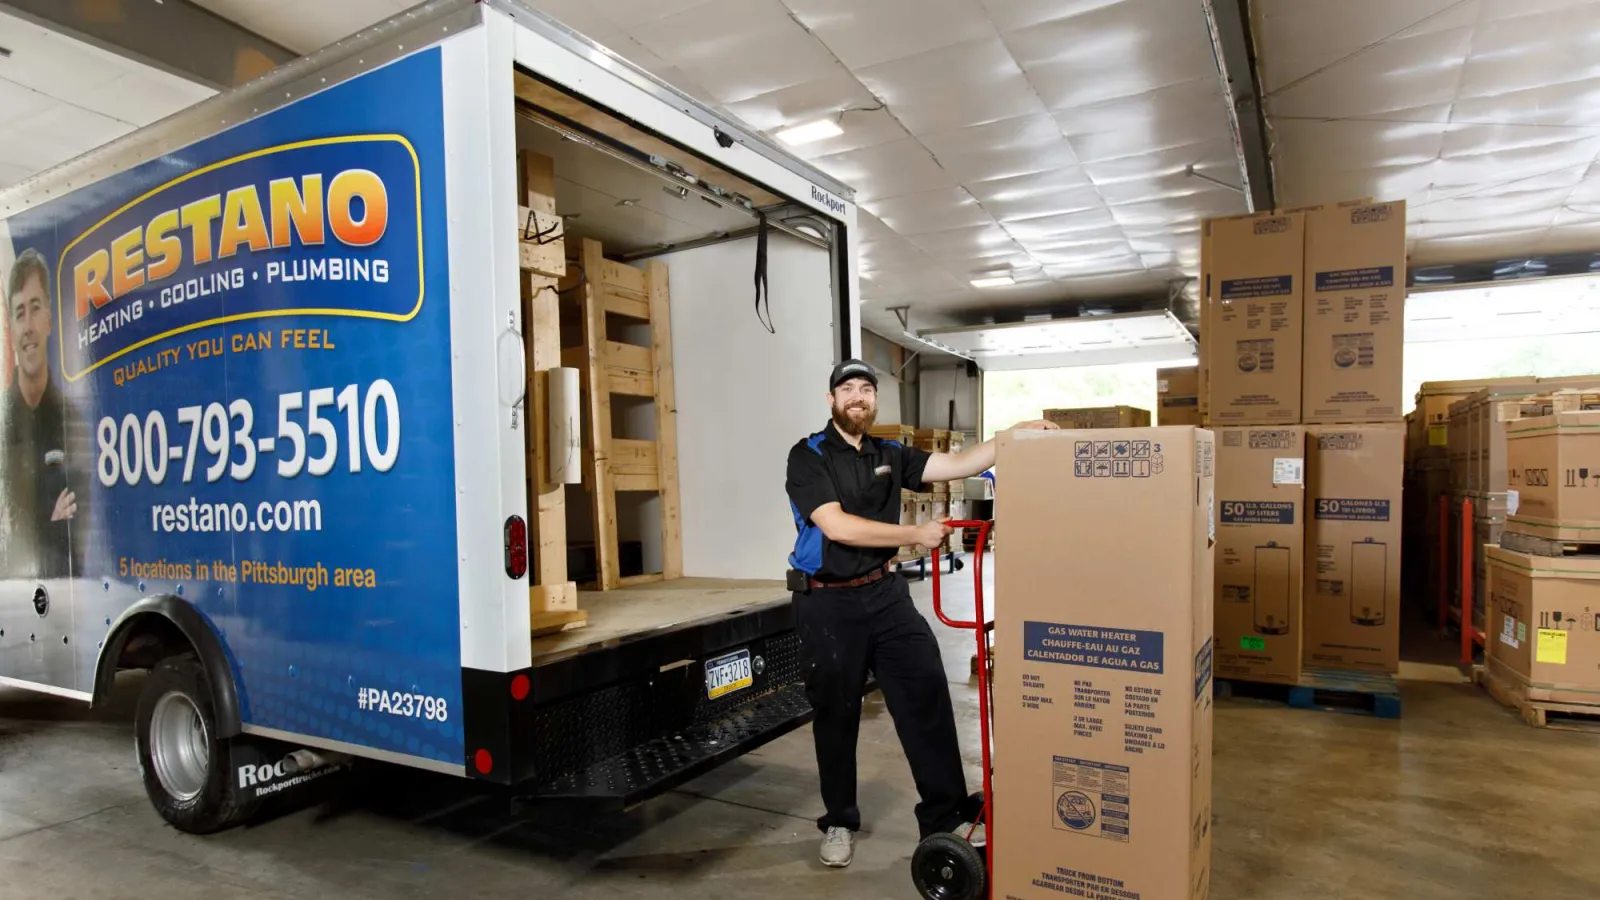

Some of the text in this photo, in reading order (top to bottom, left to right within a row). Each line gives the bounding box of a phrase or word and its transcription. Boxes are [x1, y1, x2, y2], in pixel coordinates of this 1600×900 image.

[811, 185, 846, 216] Rockport
[73, 168, 389, 322] RESTANO
[77, 258, 389, 349] HEATING COOLING PLUMBING
[113, 328, 335, 387] QUALITY YOU CAN FEEL
[97, 378, 400, 488] 800-793-5510
[1153, 443, 1161, 452] 3
[152, 497, 322, 533] restano.com
[1224, 502, 1245, 516] 50
[1319, 500, 1339, 513] 50
[119, 557, 376, 591] 5 locations in the Pittsburgh area
[1041, 638, 1141, 656] CHAUFFE-EAU AU GAZ
[1048, 626, 1137, 642] GAS WATER HEATER
[1027, 649, 1159, 670] CALENTADOR DE AGUA A GAS
[358, 687, 448, 722] #PA23798
[1041, 872, 1086, 888] TRANSPORTER
[1086, 883, 1099, 891] PAR
[1110, 887, 1141, 900] DESSOUS
[1056, 867, 1125, 888] TRUCK FROM BOTTOM
[1065, 887, 1085, 897] DESDE
[1086, 891, 1095, 899] LA
